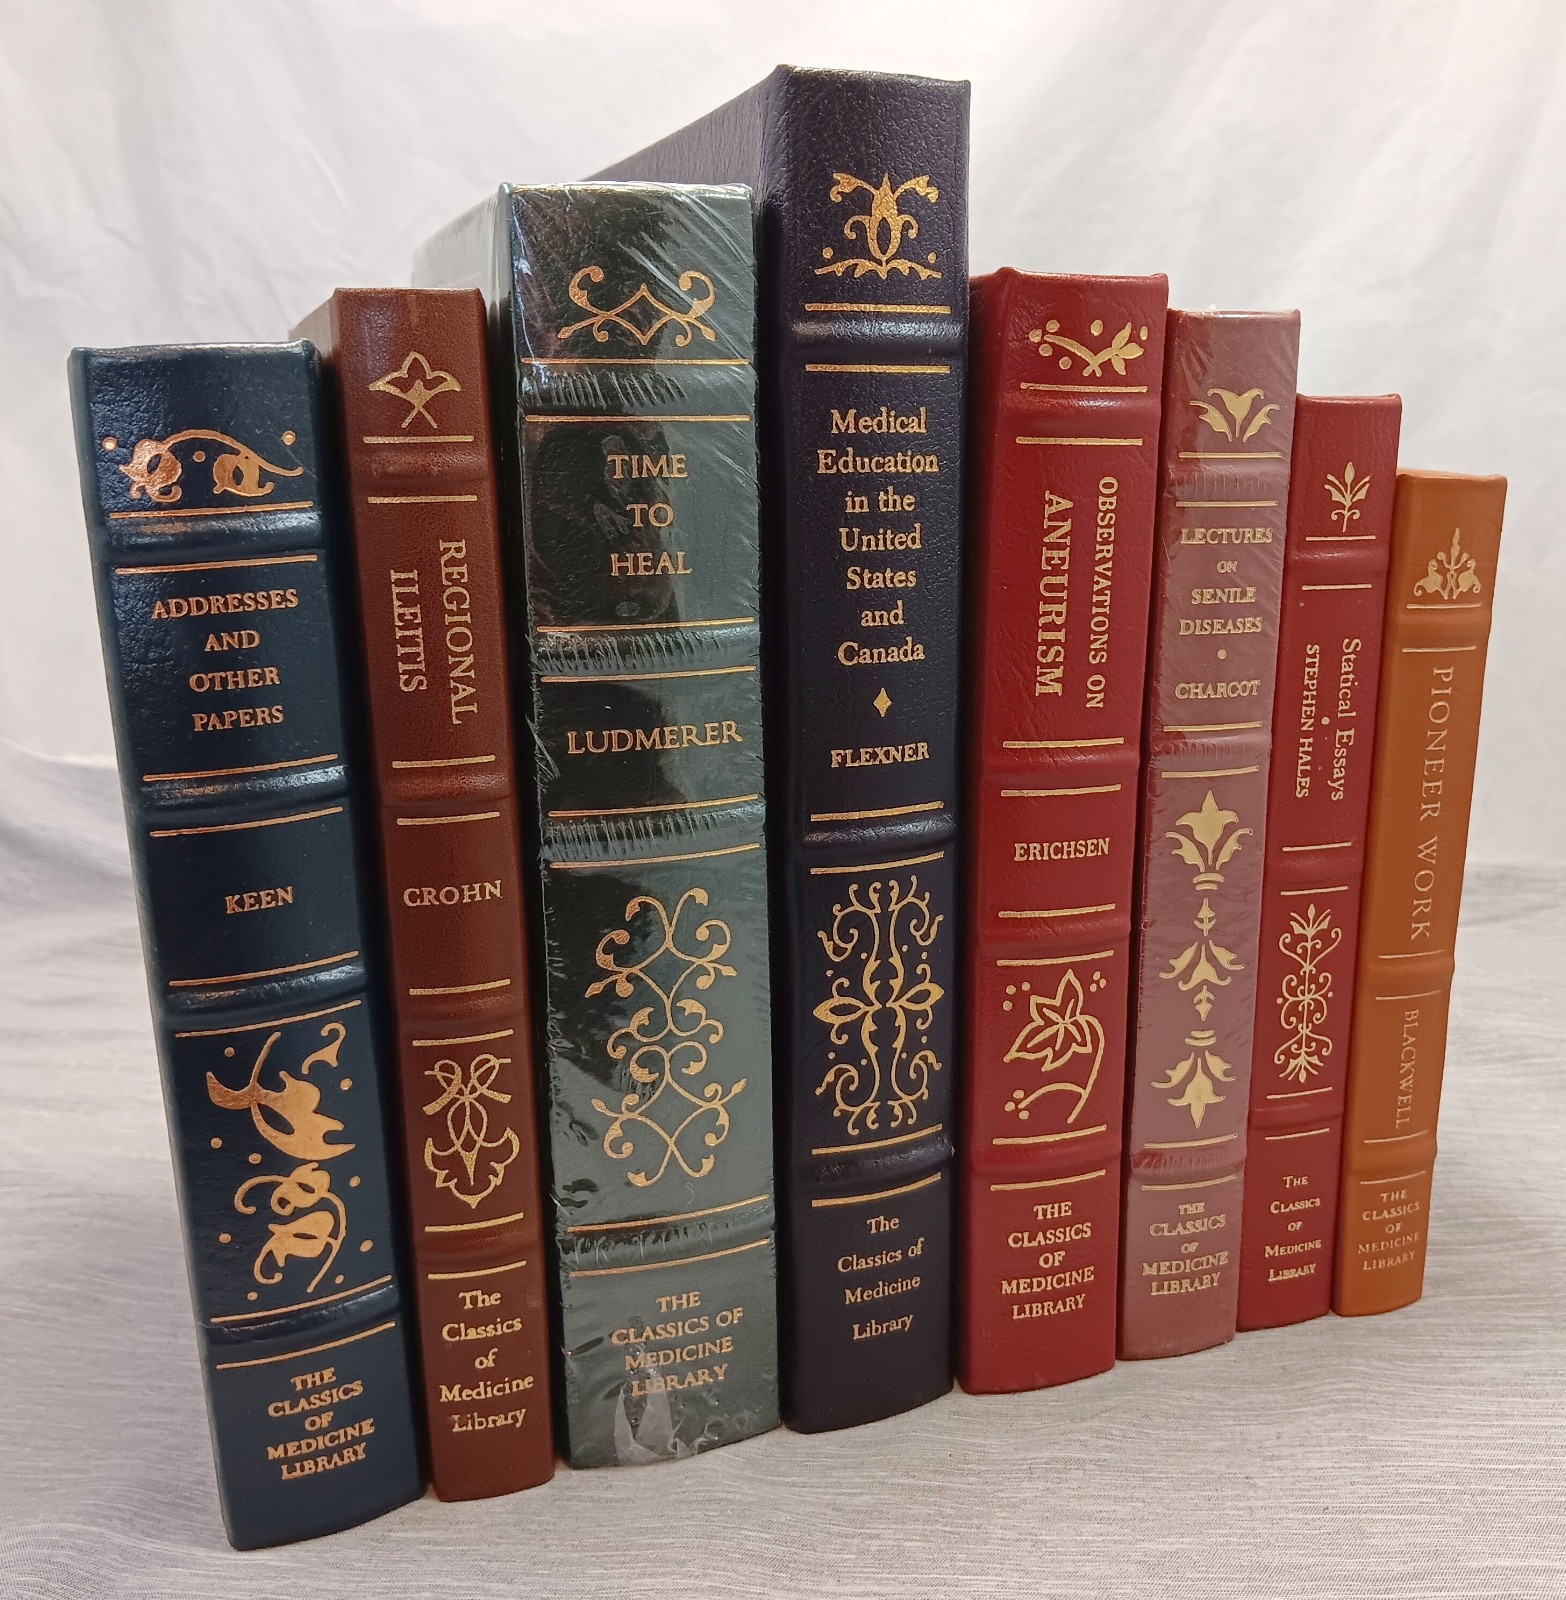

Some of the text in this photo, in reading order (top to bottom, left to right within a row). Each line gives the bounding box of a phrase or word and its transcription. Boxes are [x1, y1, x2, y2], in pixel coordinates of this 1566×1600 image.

[831, 409, 927, 433] Medical
[607, 453, 688, 480] TIME
[817, 448, 939, 474] Education
[845, 487, 916, 513] in the
[626, 503, 674, 527] TO
[839, 524, 922, 551] United
[1180, 528, 1273, 545] LECTURES
[610, 552, 693, 576] HEAL
[1217, 560, 1237, 573] ON
[846, 567, 916, 590] States
[151, 588, 299, 620] ADDRESSES
[1036, 491, 1073, 696] ANEURISM
[1086, 476, 1119, 708] OBSERVATIONS ON
[1191, 587, 1256, 604] SENILE
[860, 601, 904, 626] and
[1179, 617, 1262, 635] DISEASES
[205, 630, 260, 652] AND
[390, 569, 427, 692] ILEITIS
[439, 539, 477, 725] REGIONAL
[837, 638, 925, 666] Canada
[189, 667, 280, 692] OTHER
[1175, 680, 1260, 699] CHARCOT
[193, 705, 284, 731] PAPERS
[1296, 645, 1319, 798] STEPHEN HALES
[1331, 638, 1361, 801] Statical Essays
[567, 720, 742, 754] LUDMERER
[831, 742, 929, 768] FLEXNER
[1411, 666, 1454, 940] PIONEER WORK
[1014, 838, 1110, 861] ERICHSEN
[226, 886, 293, 914] KEEN
[404, 880, 502, 906] CROHN
[1396, 1009, 1419, 1129] BLACKWELL
[1380, 1189, 1408, 1202] THE
[1033, 1201, 1072, 1220] THE
[1178, 1202, 1205, 1215] THE
[1362, 1202, 1420, 1221] CLASSICS
[867, 1216, 899, 1233] The
[1008, 1222, 1092, 1248] CLASSICS
[1150, 1214, 1226, 1237] CLASSICS
[1385, 1222, 1401, 1234] OF
[837, 1237, 925, 1273] Classics of
[1181, 1242, 1199, 1253] OF
[1358, 1232, 1419, 1254] MEDICINE
[1039, 1251, 1065, 1268] OF
[1142, 1251, 1228, 1275] MEDICINE
[1363, 1251, 1415, 1271] LIBRARY
[845, 1274, 921, 1304] Medicine
[1001, 1266, 1094, 1294] MEDICINE
[1151, 1272, 1221, 1295] LIBRARY
[459, 1290, 501, 1309] The
[656, 1292, 701, 1312] THE
[1012, 1294, 1086, 1319] LIBRARY
[442, 1317, 522, 1341] Classics
[612, 1307, 743, 1345] CLASSICS OF
[852, 1313, 913, 1340] Library
[475, 1348, 498, 1369] of
[625, 1336, 733, 1370] MEDICINE
[291, 1367, 336, 1391] THE
[440, 1375, 533, 1402] Medicine
[632, 1363, 728, 1396] LIBRARY
[268, 1380, 363, 1417] CLASSICS
[305, 1412, 333, 1431] OF
[452, 1408, 526, 1432] Library
[267, 1417, 374, 1461] MEDICINE
[281, 1442, 367, 1480] LIBRARY
